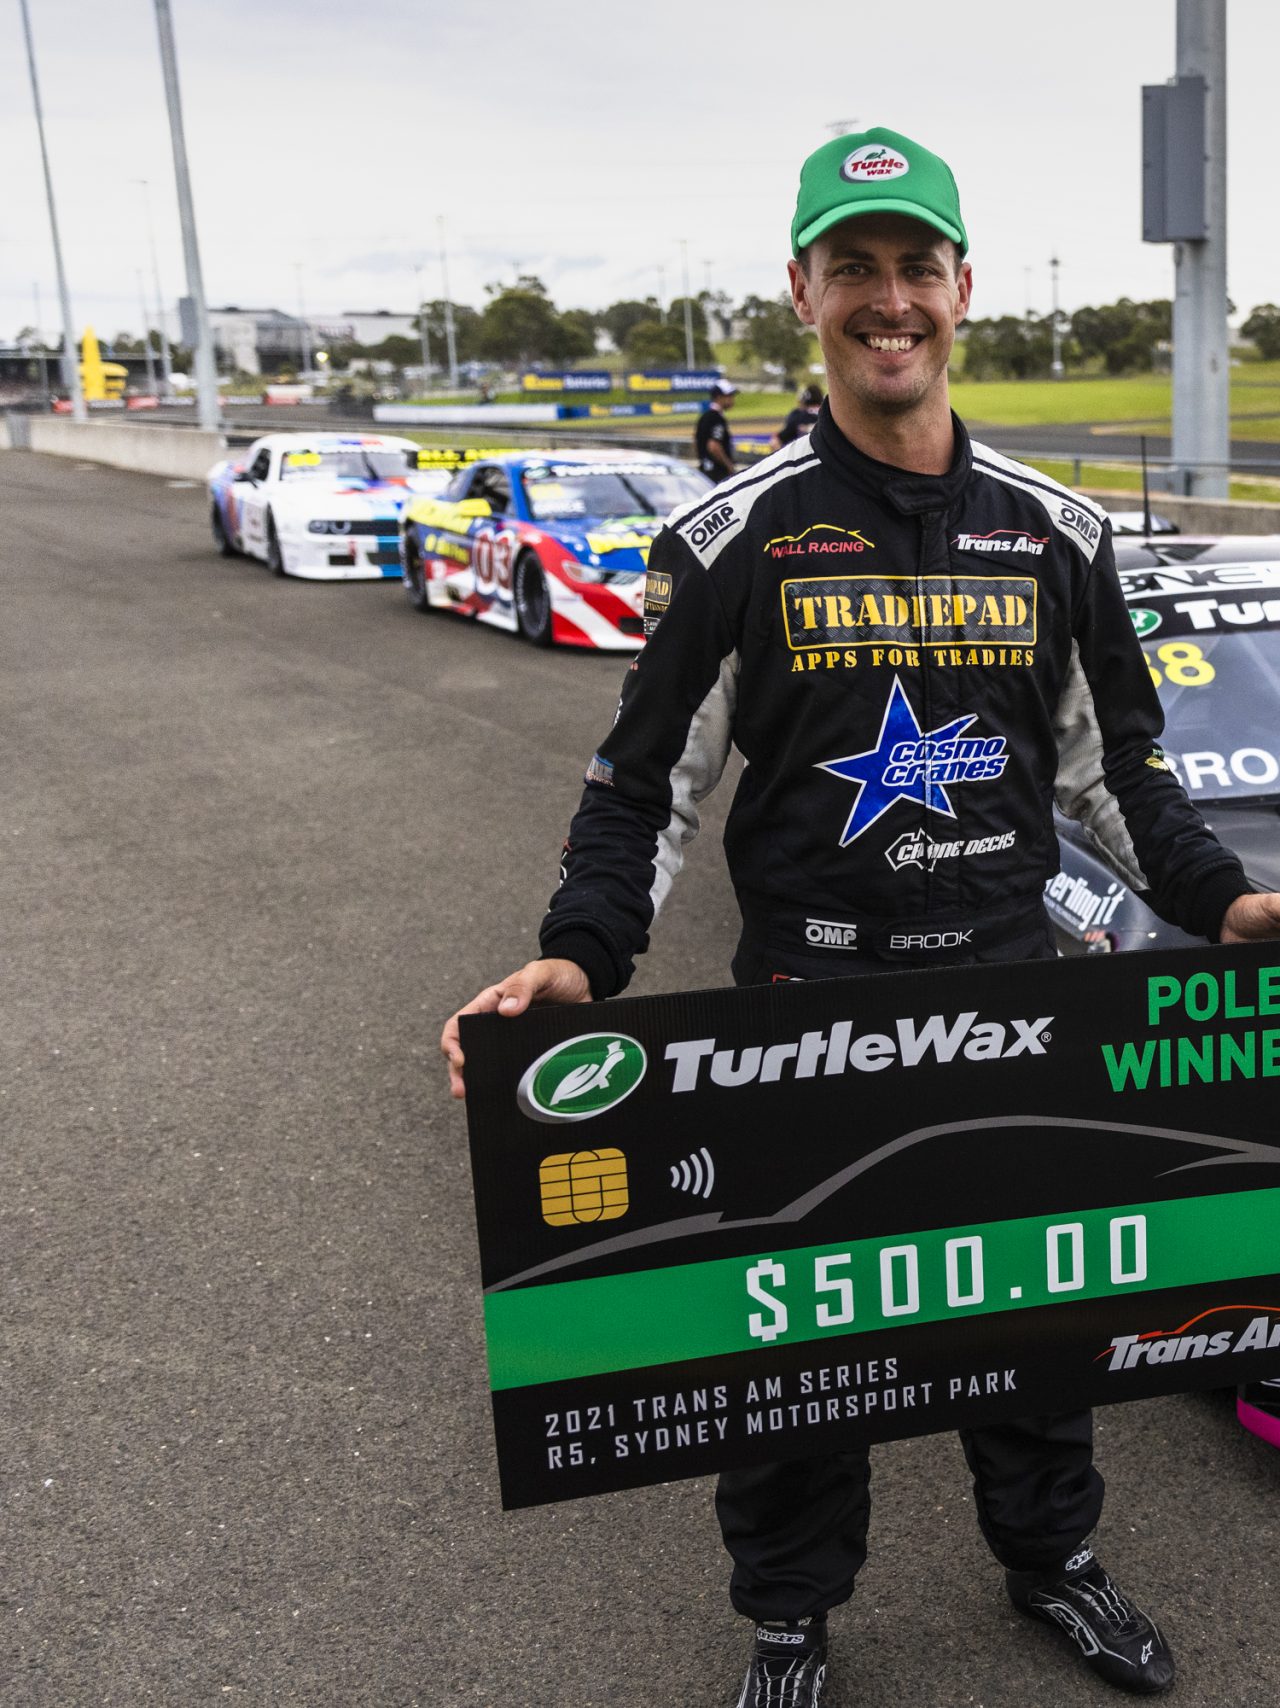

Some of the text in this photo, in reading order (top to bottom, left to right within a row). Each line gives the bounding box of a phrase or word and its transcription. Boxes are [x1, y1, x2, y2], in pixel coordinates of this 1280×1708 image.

[851, 158, 905, 173] Turtle
[690, 506, 734, 546] OMP
[1060, 507, 1099, 541] OMP
[771, 541, 865, 558] WALL RACING
[957, 534, 1044, 555] Trans Am
[794, 593, 1028, 630] TRADIEPAD
[791, 649, 1034, 672] APPS FOR TRADIES
[963, 830, 1017, 856] DECKS
[805, 924, 858, 946] OMP
[890, 929, 974, 949] BROOK
[746, 1214, 1148, 1342] $500.00
[1108, 1331, 1234, 1371] Trans
[545, 1357, 899, 1437] 2021 TRANS AM SERIES
[547, 1369, 1018, 1470] R5, SYDNEY MOTORSPORT PARK
